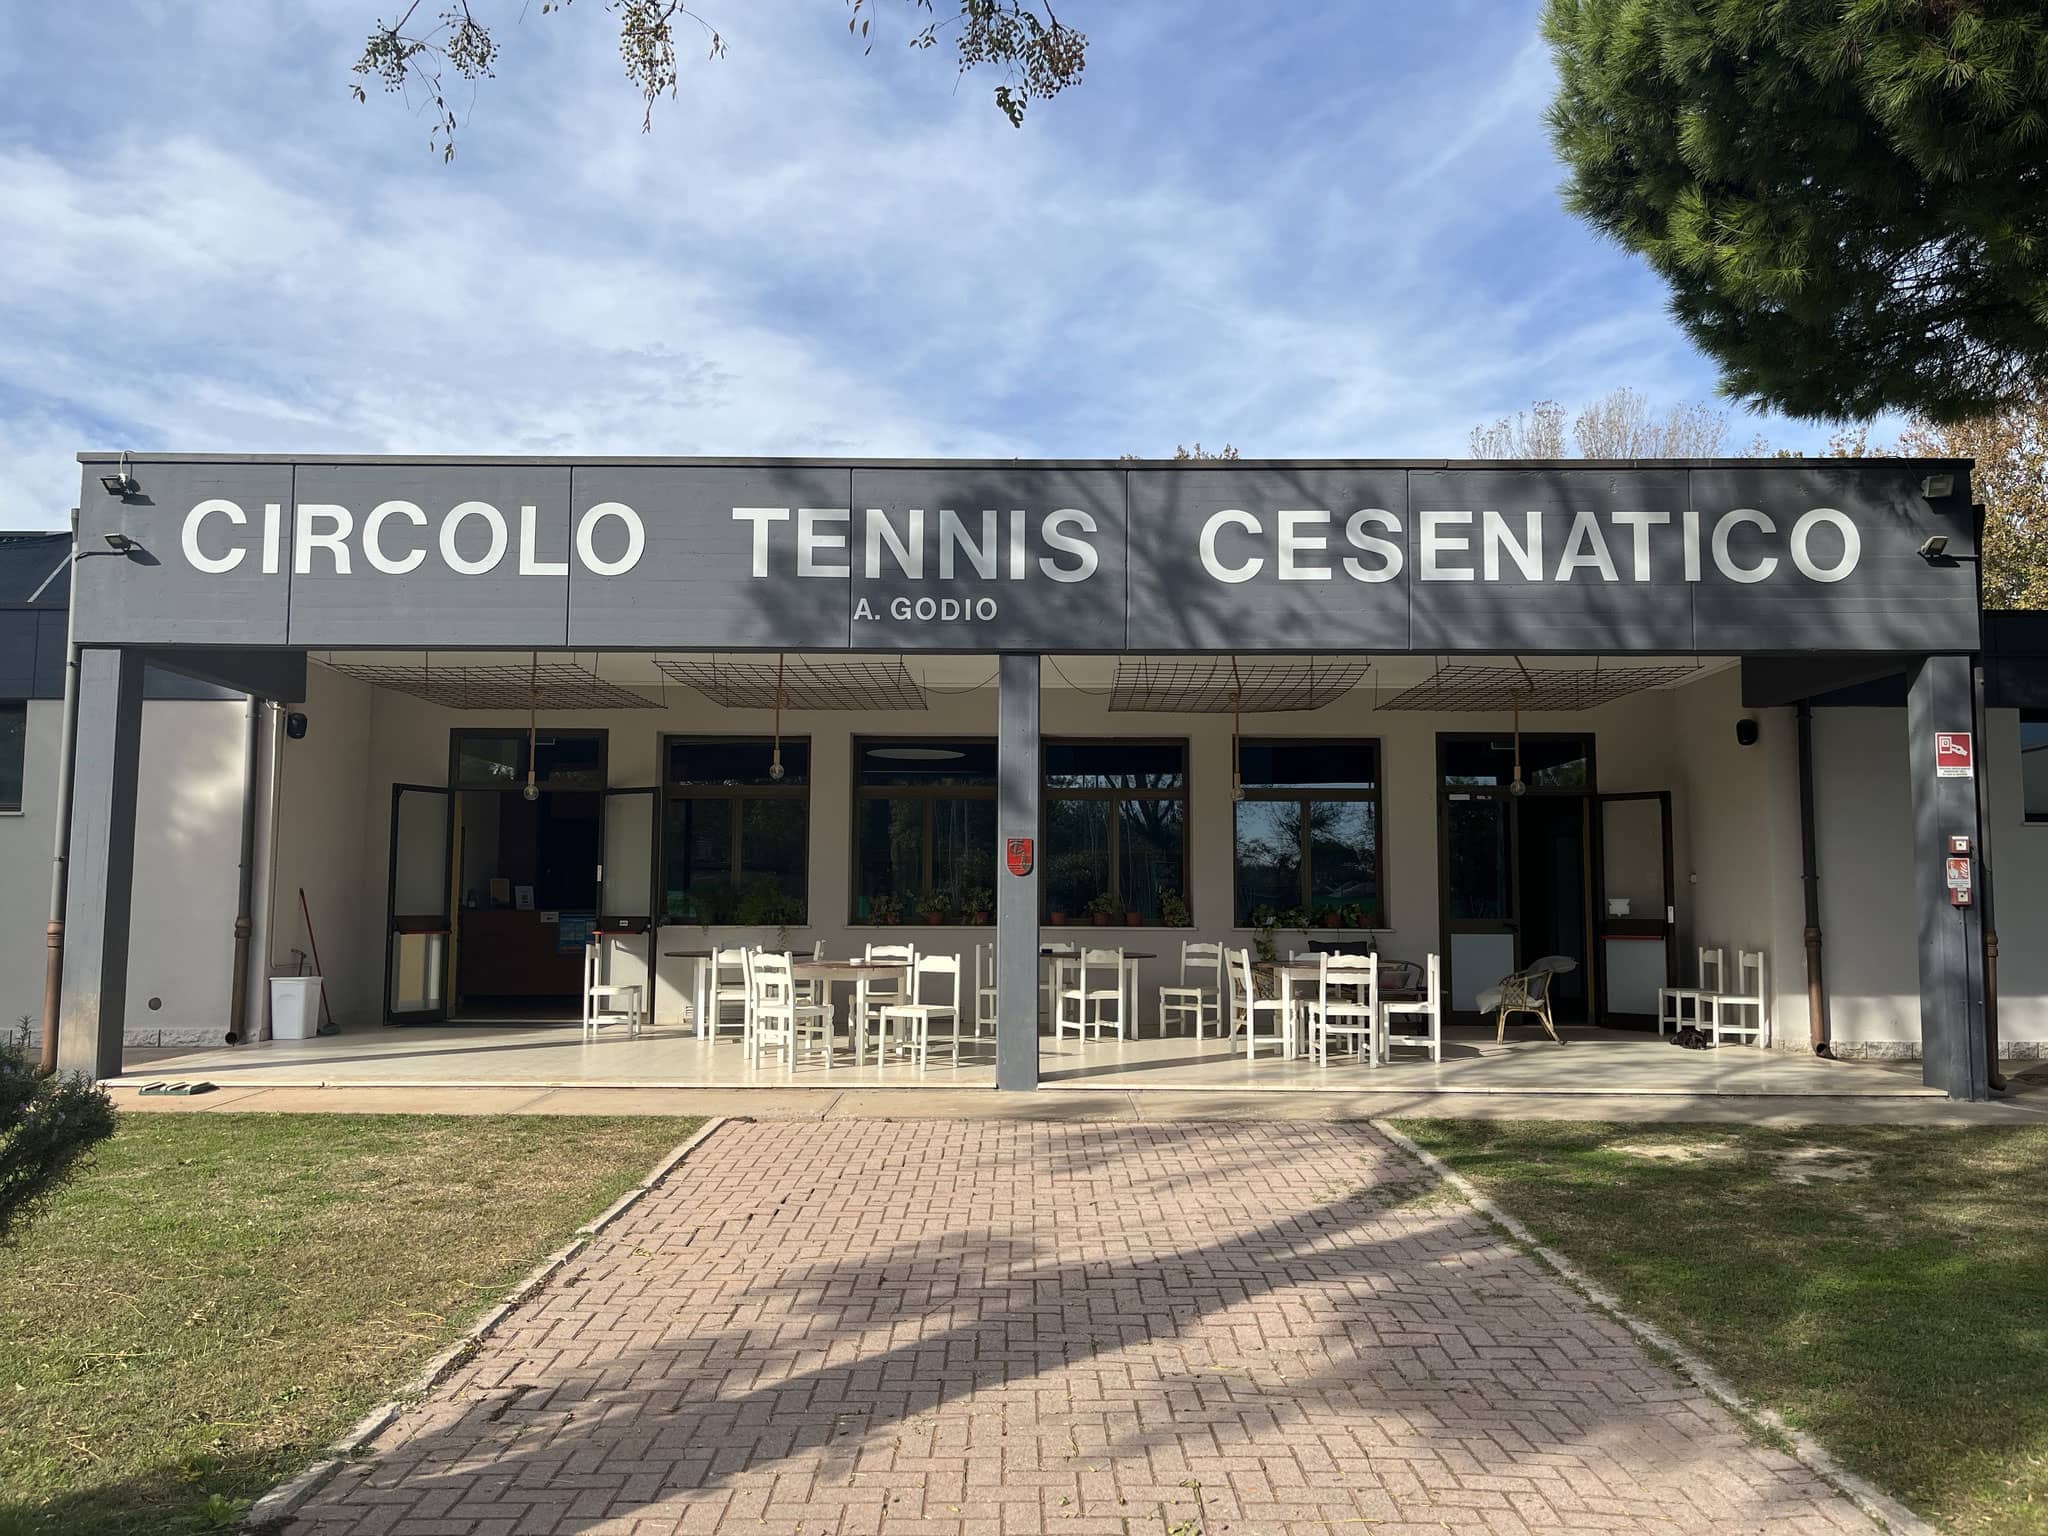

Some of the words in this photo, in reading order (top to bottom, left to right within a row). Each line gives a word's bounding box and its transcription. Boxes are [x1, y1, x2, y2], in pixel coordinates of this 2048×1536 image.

[181, 499, 646, 576] CIRCOLO
[732, 507, 1099, 583] TENNIS
[1199, 508, 1861, 583] CESENATICO
[853, 598, 881, 620] A.
[890, 597, 998, 621] GODIO
